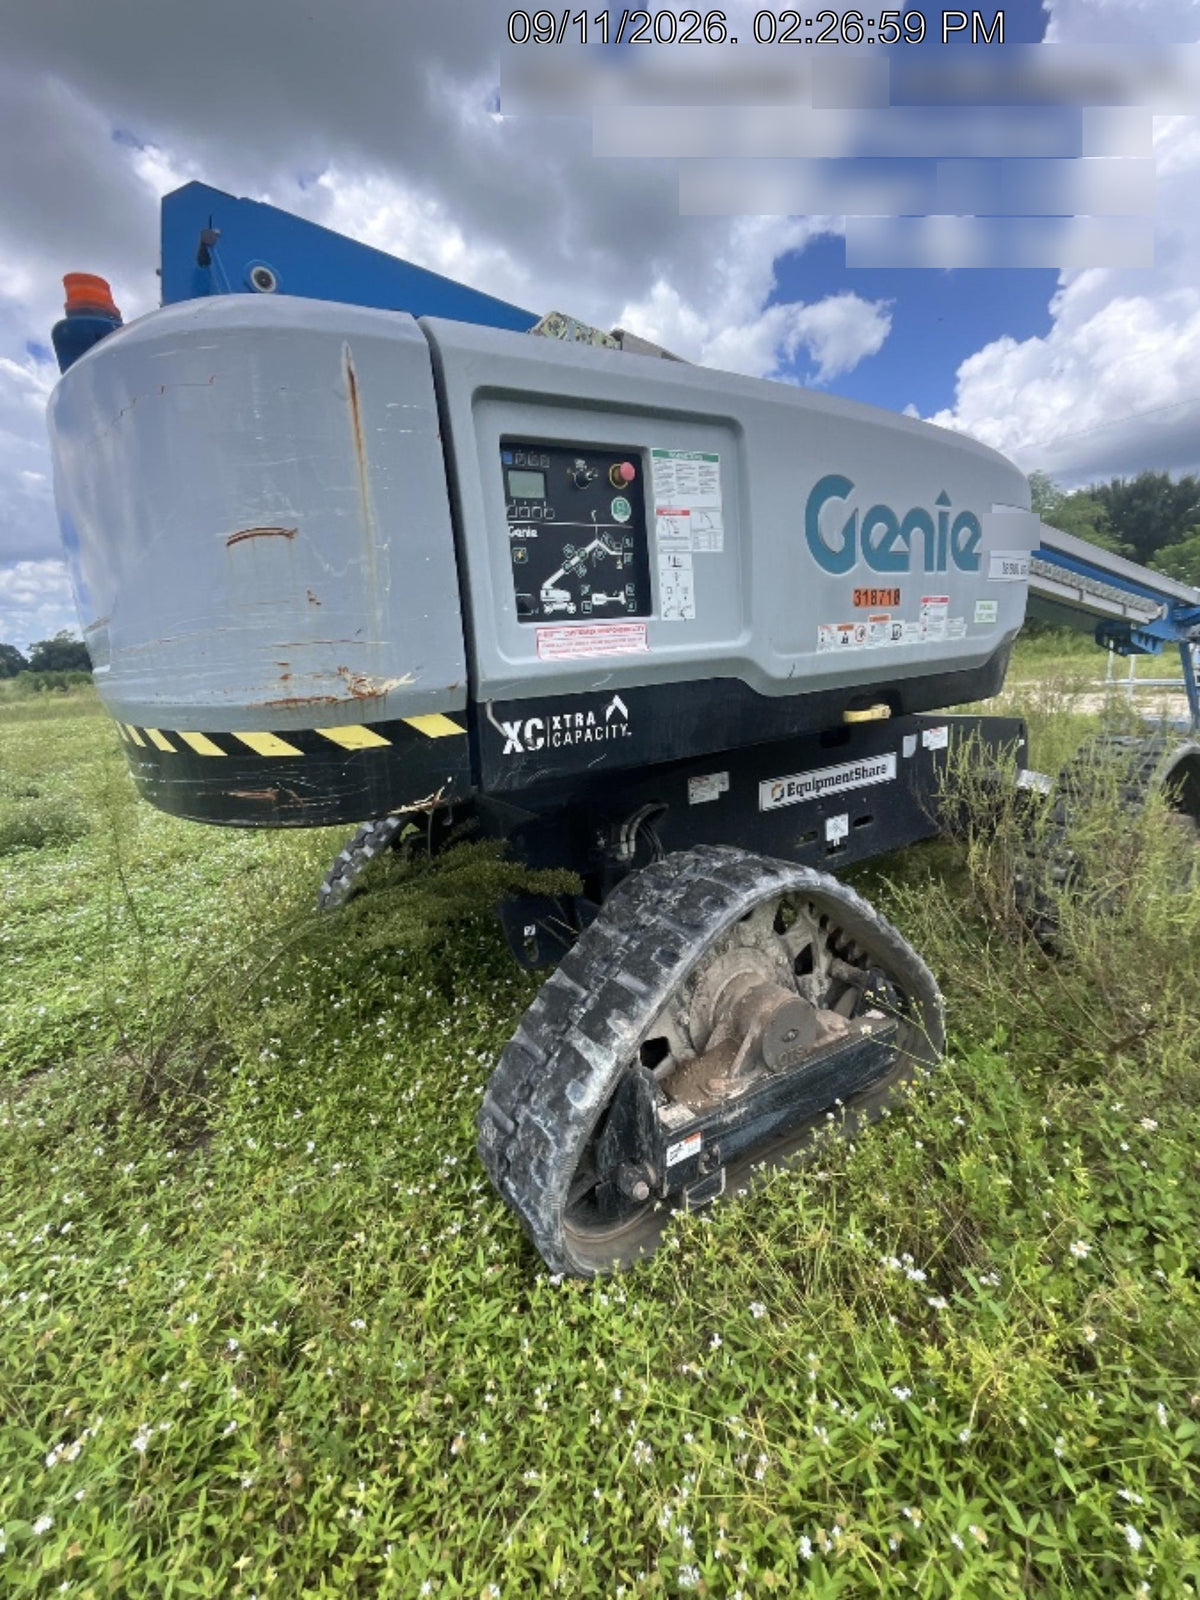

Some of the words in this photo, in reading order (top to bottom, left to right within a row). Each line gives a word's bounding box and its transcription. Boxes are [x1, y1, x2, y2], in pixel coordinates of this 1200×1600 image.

[508, 525, 538, 538] Genie
[805, 474, 983, 575] Genie
[502, 717, 546, 755] XC
[552, 711, 597, 730] XTRA
[787, 763, 889, 797] EquipmentShare
